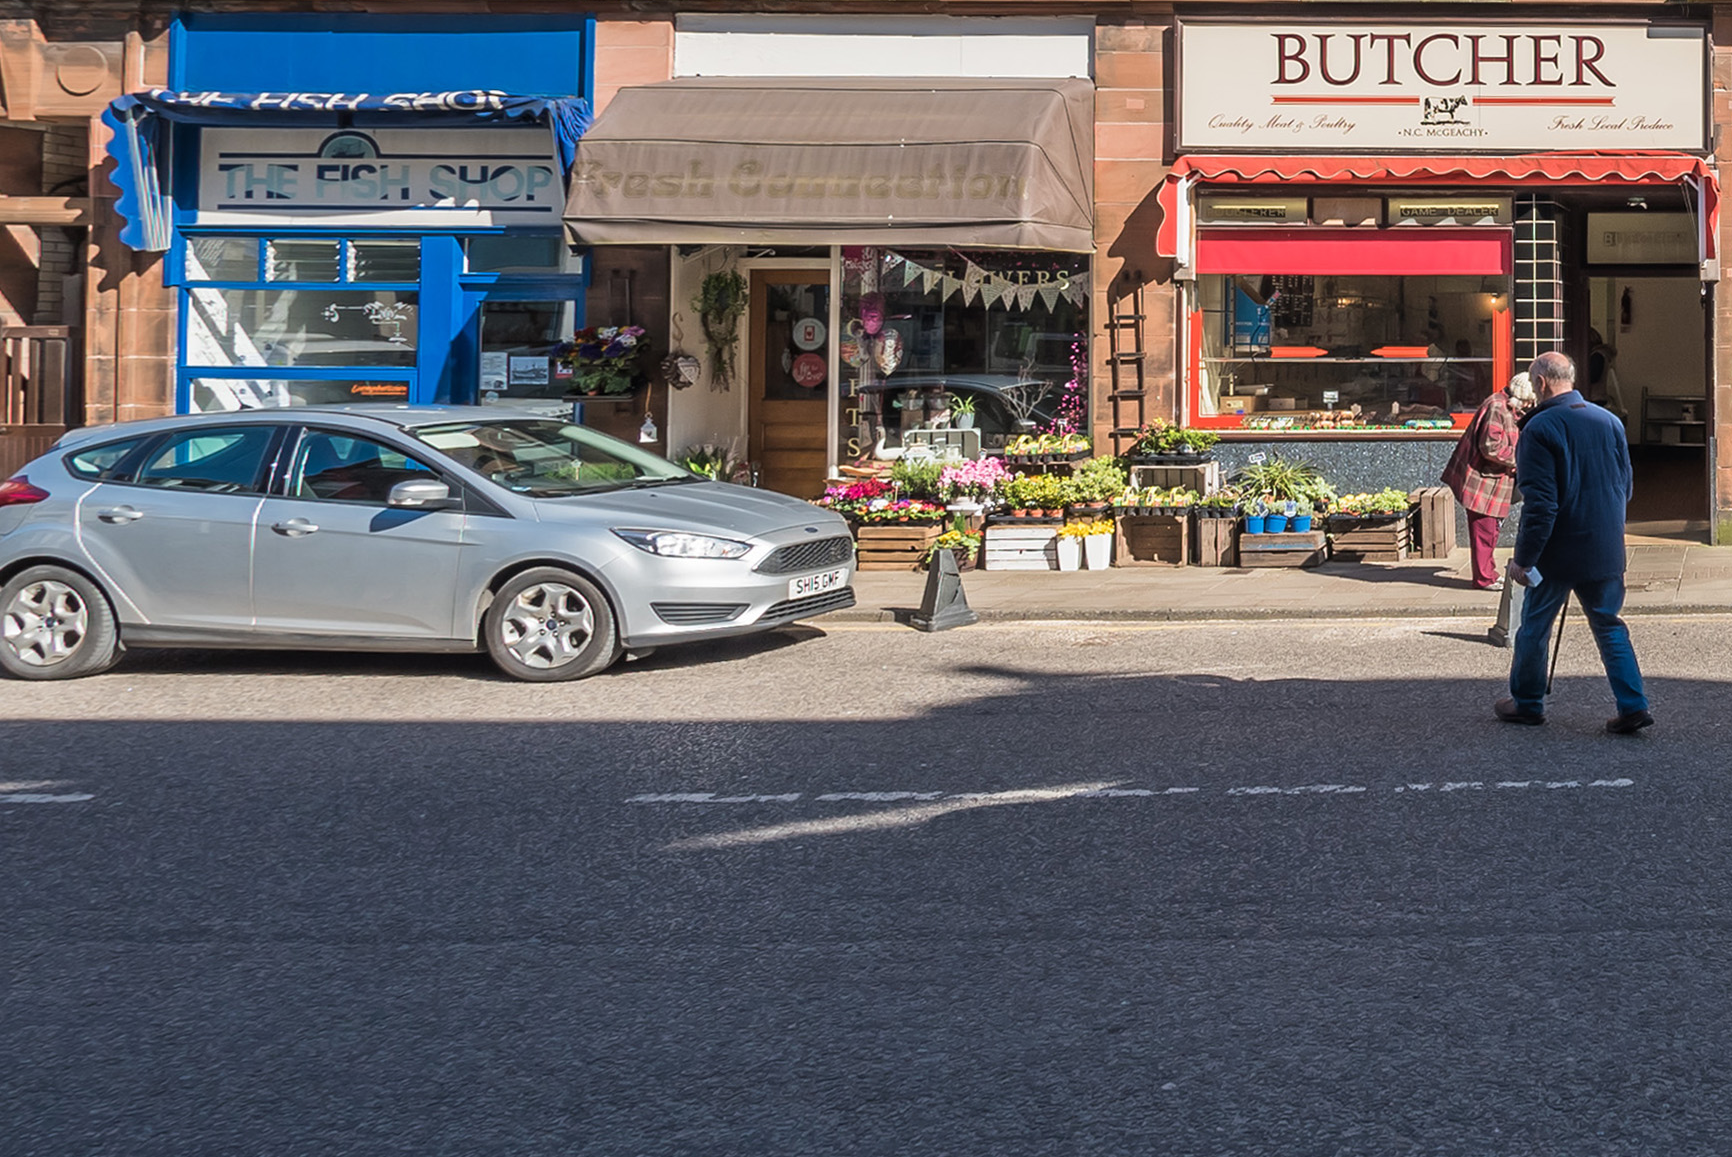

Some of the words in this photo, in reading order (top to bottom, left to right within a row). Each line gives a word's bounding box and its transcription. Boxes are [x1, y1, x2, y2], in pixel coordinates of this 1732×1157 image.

[1270, 32, 1616, 87] BUTCHER
[1208, 114, 1254, 134] Quality
[1259, 114, 1295, 129] Meat
[1309, 114, 1356, 135] Poultry
[1403, 128, 1423, 137] N.C.
[1426, 128, 1484, 137] McGEACHY
[1547, 115, 1585, 130] Fresh
[1587, 115, 1625, 131] Local
[1626, 115, 1674, 131] Produce
[218, 164, 299, 199] THE
[316, 164, 410, 200] FISH
[429, 164, 552, 202] SHOP
[574, 158, 714, 200] Fresh
[728, 159, 1028, 201] Connection
[1401, 207, 1437, 216] GAME
[1447, 207, 1498, 216] DEALER
[845, 317, 864, 457] GFTS
[796, 575, 821, 594] SH15
[822, 570, 840, 588] GMF
